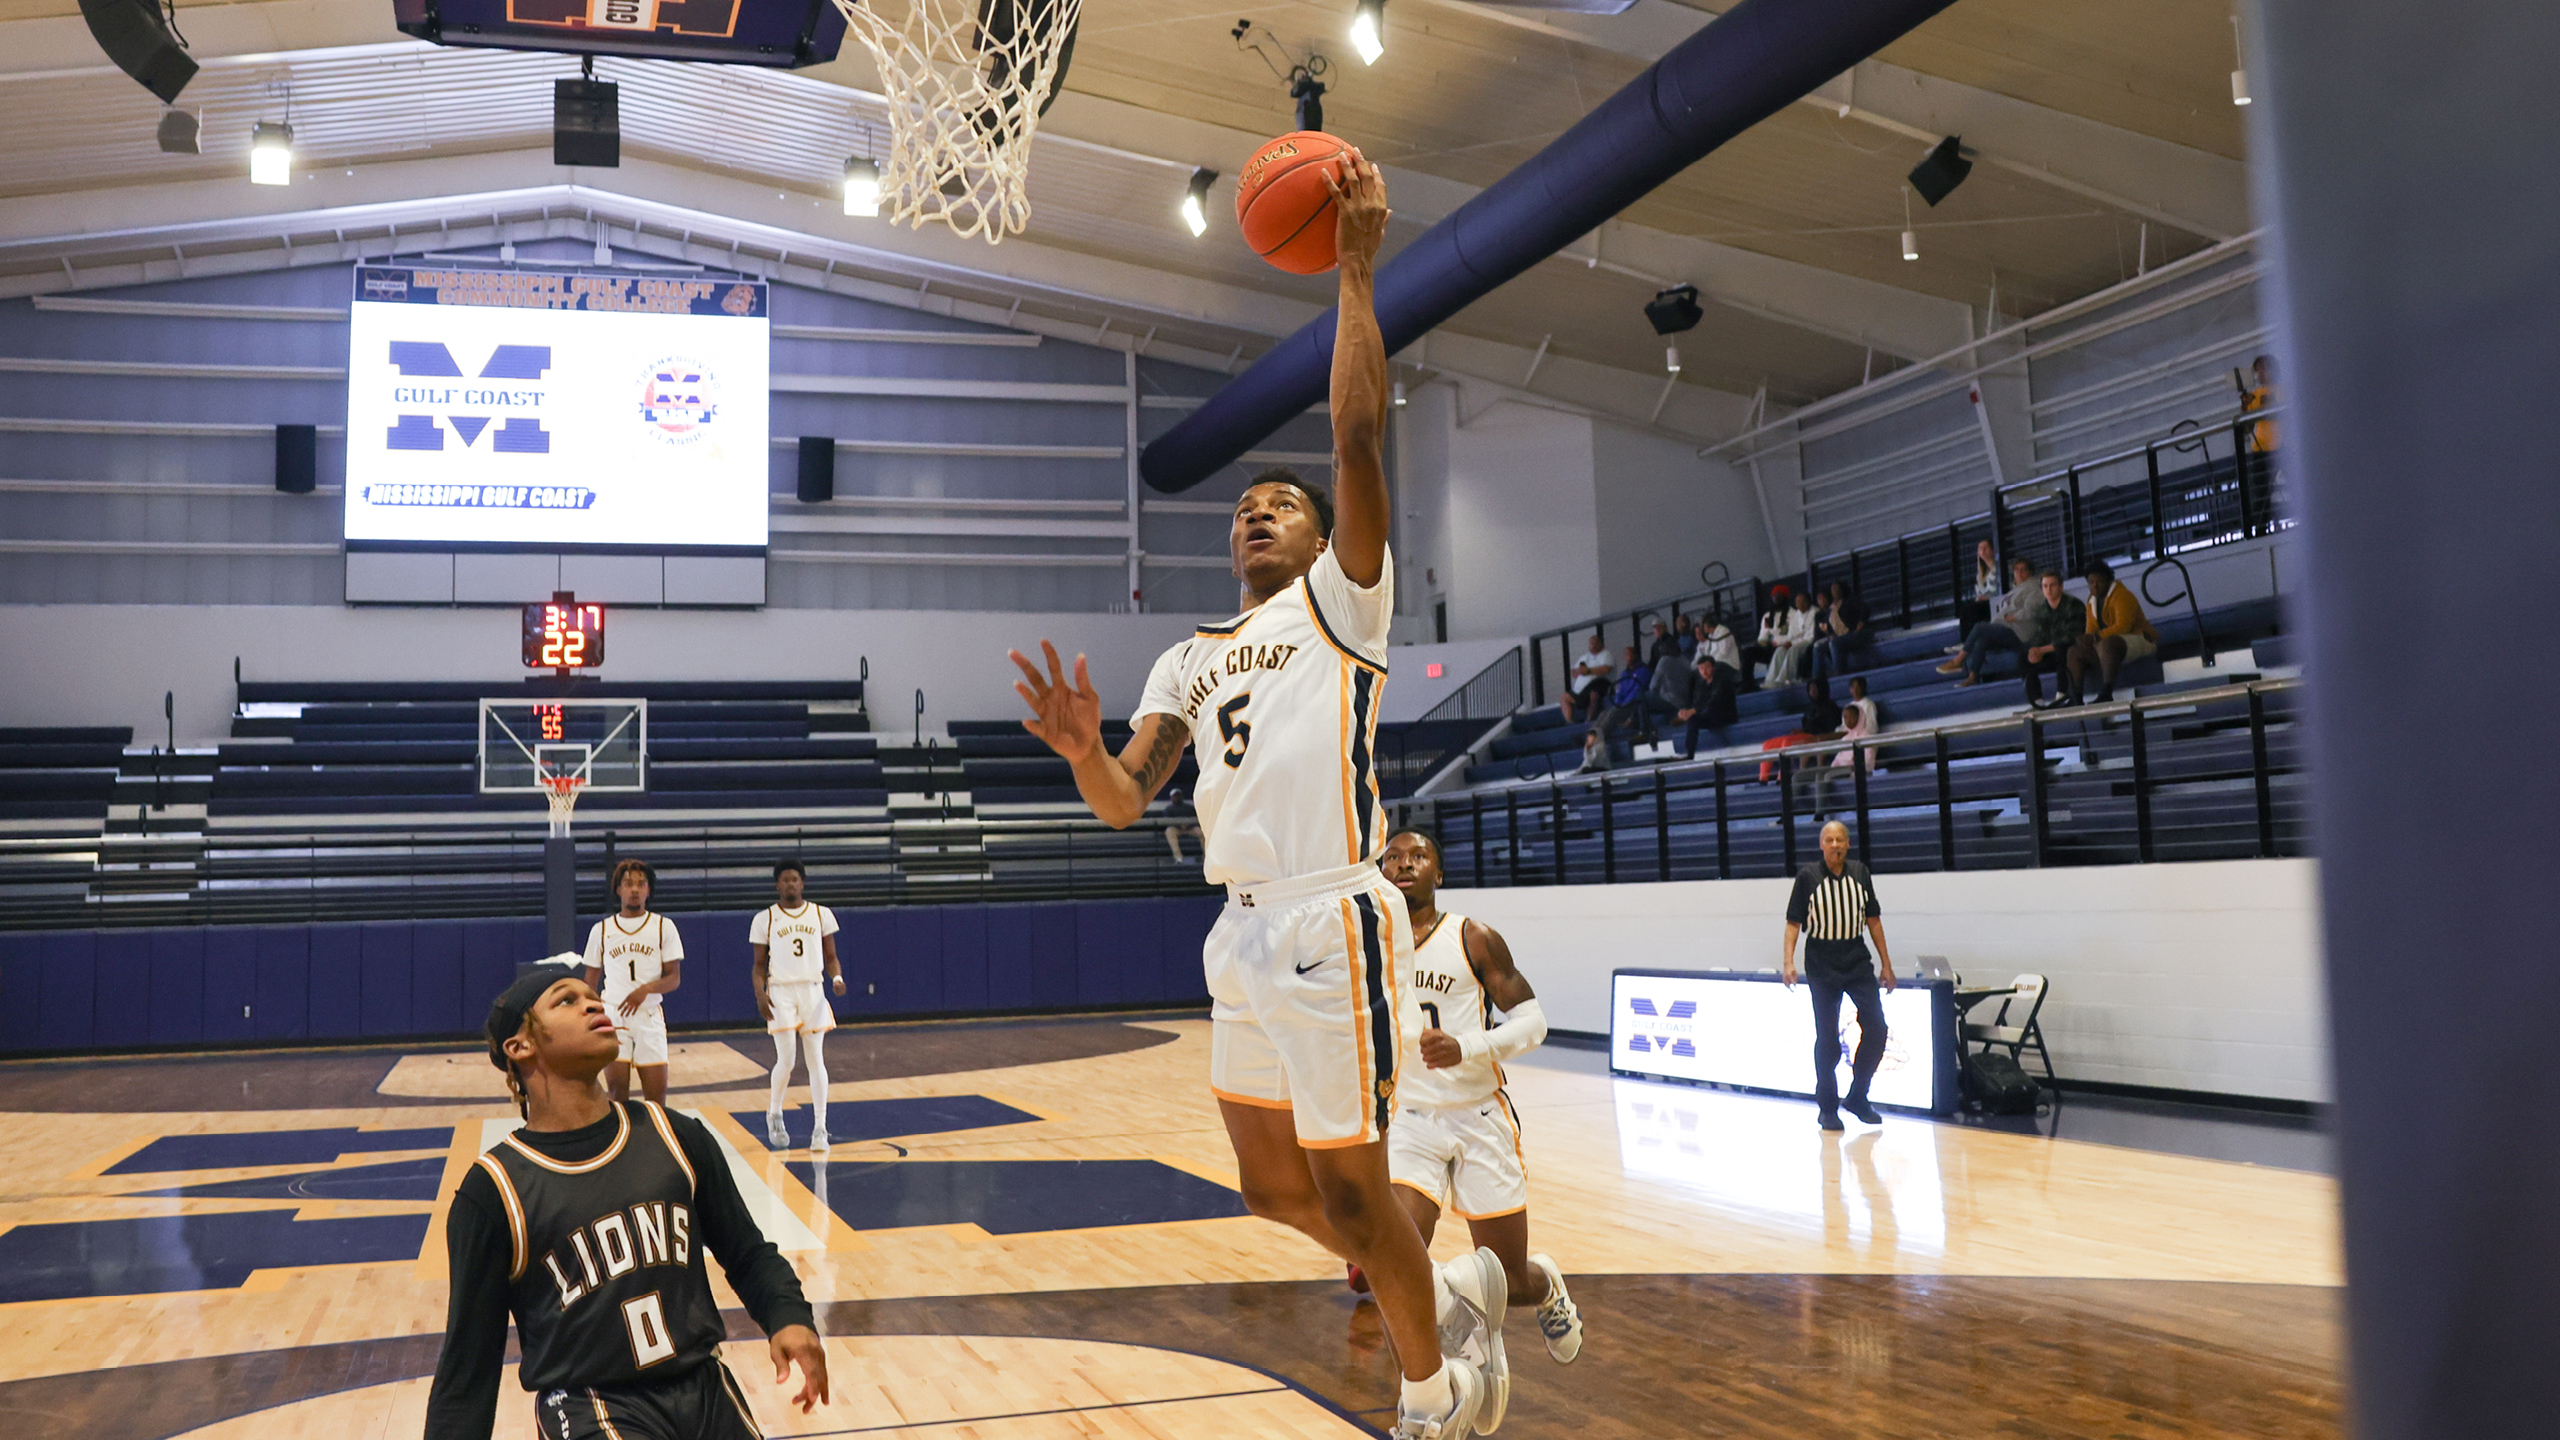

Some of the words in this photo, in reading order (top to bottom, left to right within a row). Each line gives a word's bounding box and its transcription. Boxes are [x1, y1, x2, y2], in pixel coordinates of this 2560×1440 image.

[413, 270, 565, 293] MISSISSIPPI
[570, 277, 632, 295] GULF
[637, 280, 715, 300] COAST
[436, 287, 581, 310] COMMUNITY
[586, 294, 692, 314] COLLEGE
[394, 387, 459, 404] GULF
[465, 389, 545, 406] COAST
[370, 484, 481, 505] MISSISSIPPI
[481, 487, 527, 506] GULF
[529, 488, 588, 508] COAST
[545, 606, 601, 632] 3:17
[541, 631, 584, 665] 22
[1187, 667, 1218, 720] GULF
[1226, 644, 1298, 676] COAST
[1217, 691, 1251, 770] 5
[795, 924, 816, 936] COAST
[609, 944, 627, 959] GULF
[629, 943, 654, 957] COAST
[792, 938, 804, 957] 3
[628, 959, 636, 981] 1
[1415, 970, 1456, 994] OAST
[541, 1201, 690, 1311] LIONS
[620, 1290, 676, 1371] 0
